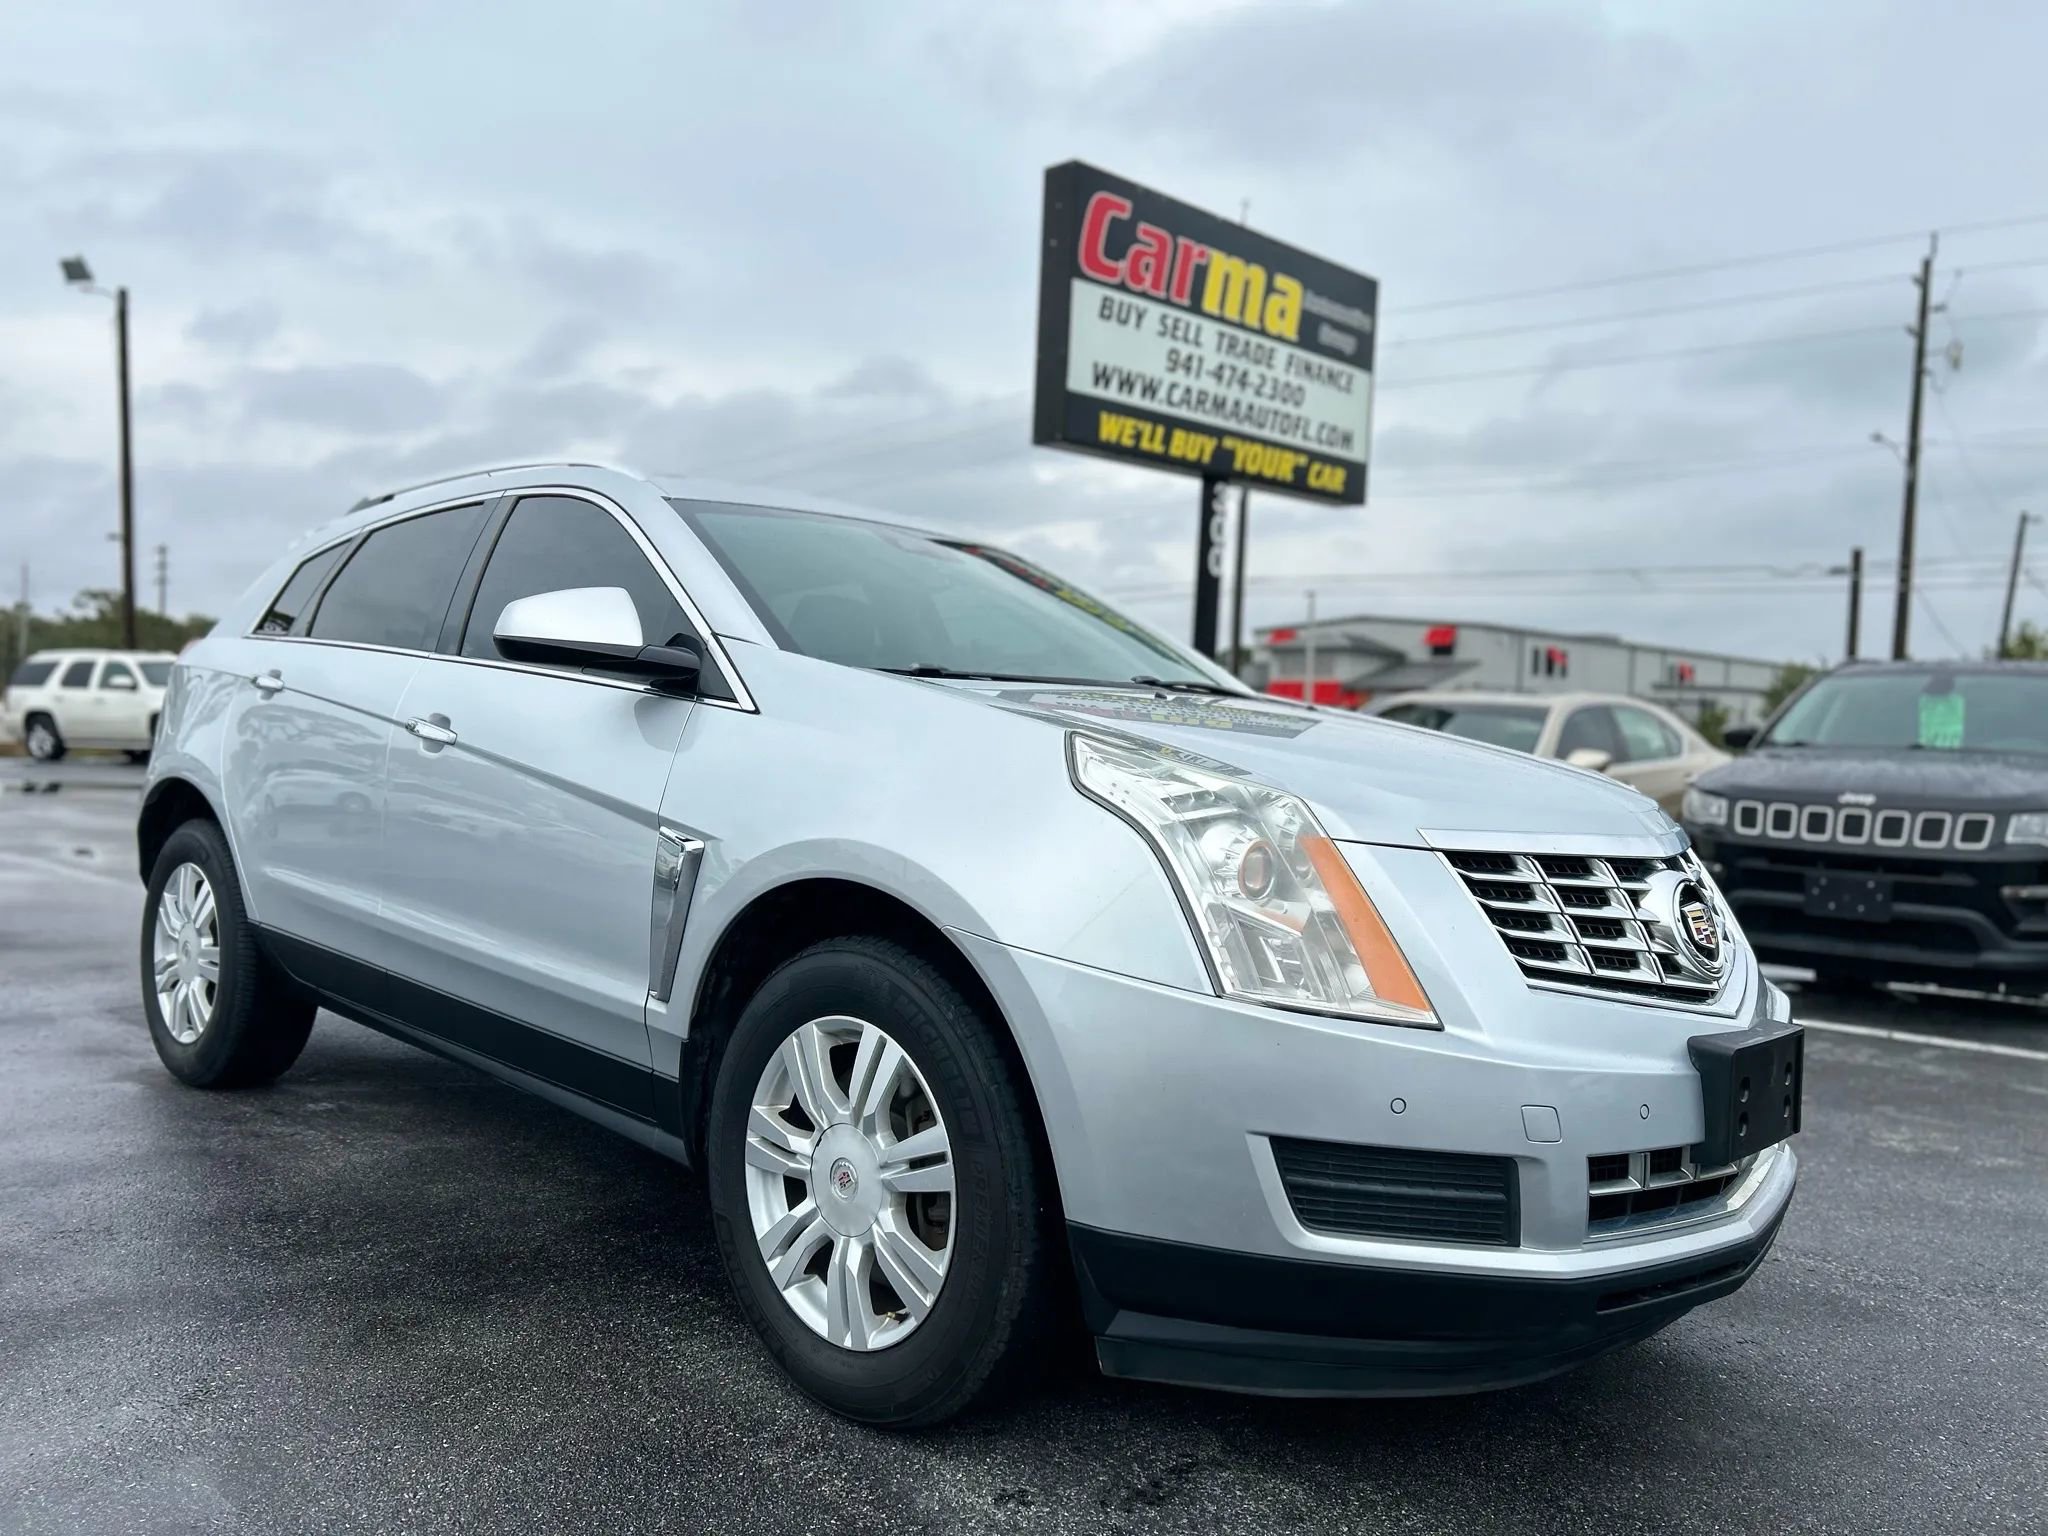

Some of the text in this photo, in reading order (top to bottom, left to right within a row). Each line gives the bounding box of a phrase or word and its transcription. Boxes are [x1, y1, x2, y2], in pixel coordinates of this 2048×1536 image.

[1078, 191, 1304, 341] Carma
[1099, 295, 1148, 331] BUY
[1157, 313, 1203, 348] SELL
[1216, 329, 1277, 371] TRADE
[1284, 352, 1355, 395] FINANCE
[1165, 347, 1306, 408] 941-474-2300
[1092, 360, 1355, 451] WWW.CARMAAUTOFL.COM
[1098, 410, 1347, 494] WE'LL BUY "YOUR" CAR
